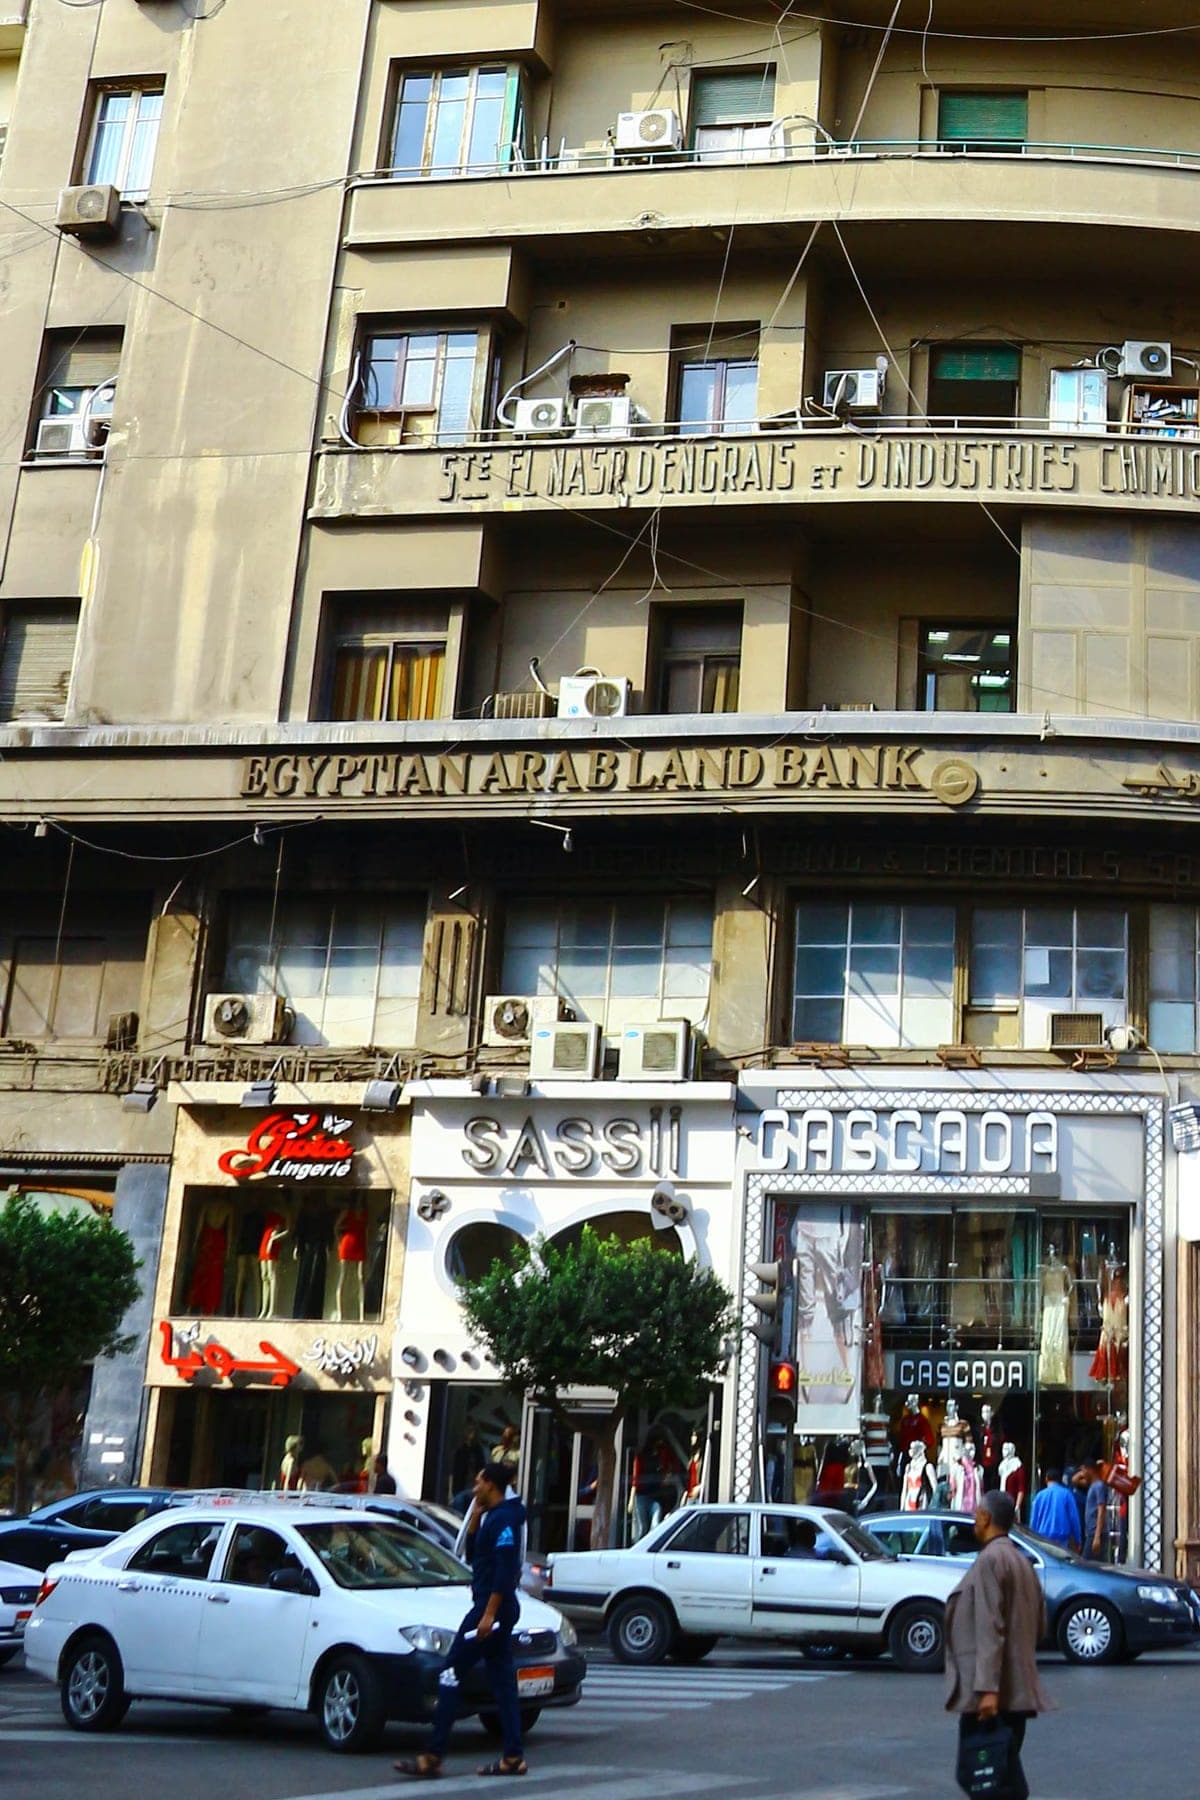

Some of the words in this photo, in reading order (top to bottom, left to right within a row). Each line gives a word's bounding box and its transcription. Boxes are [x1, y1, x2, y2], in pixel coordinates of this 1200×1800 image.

[506, 450, 537, 497] EL
[547, 446, 628, 498] NASR
[809, 465, 843, 490] ET
[856, 435, 1077, 492] D'INDUSTRIES
[240, 752, 472, 797] EGYPTIAN
[480, 748, 621, 794] ARAB
[625, 746, 765, 791] LAND
[773, 744, 926, 790] BANK
[923, 844, 1119, 879] CHEMICALS
[756, 1109, 1059, 1173] CASCADA
[268, 1159, 352, 1181] Lingerie
[898, 1359, 1024, 1389] CASCADA
